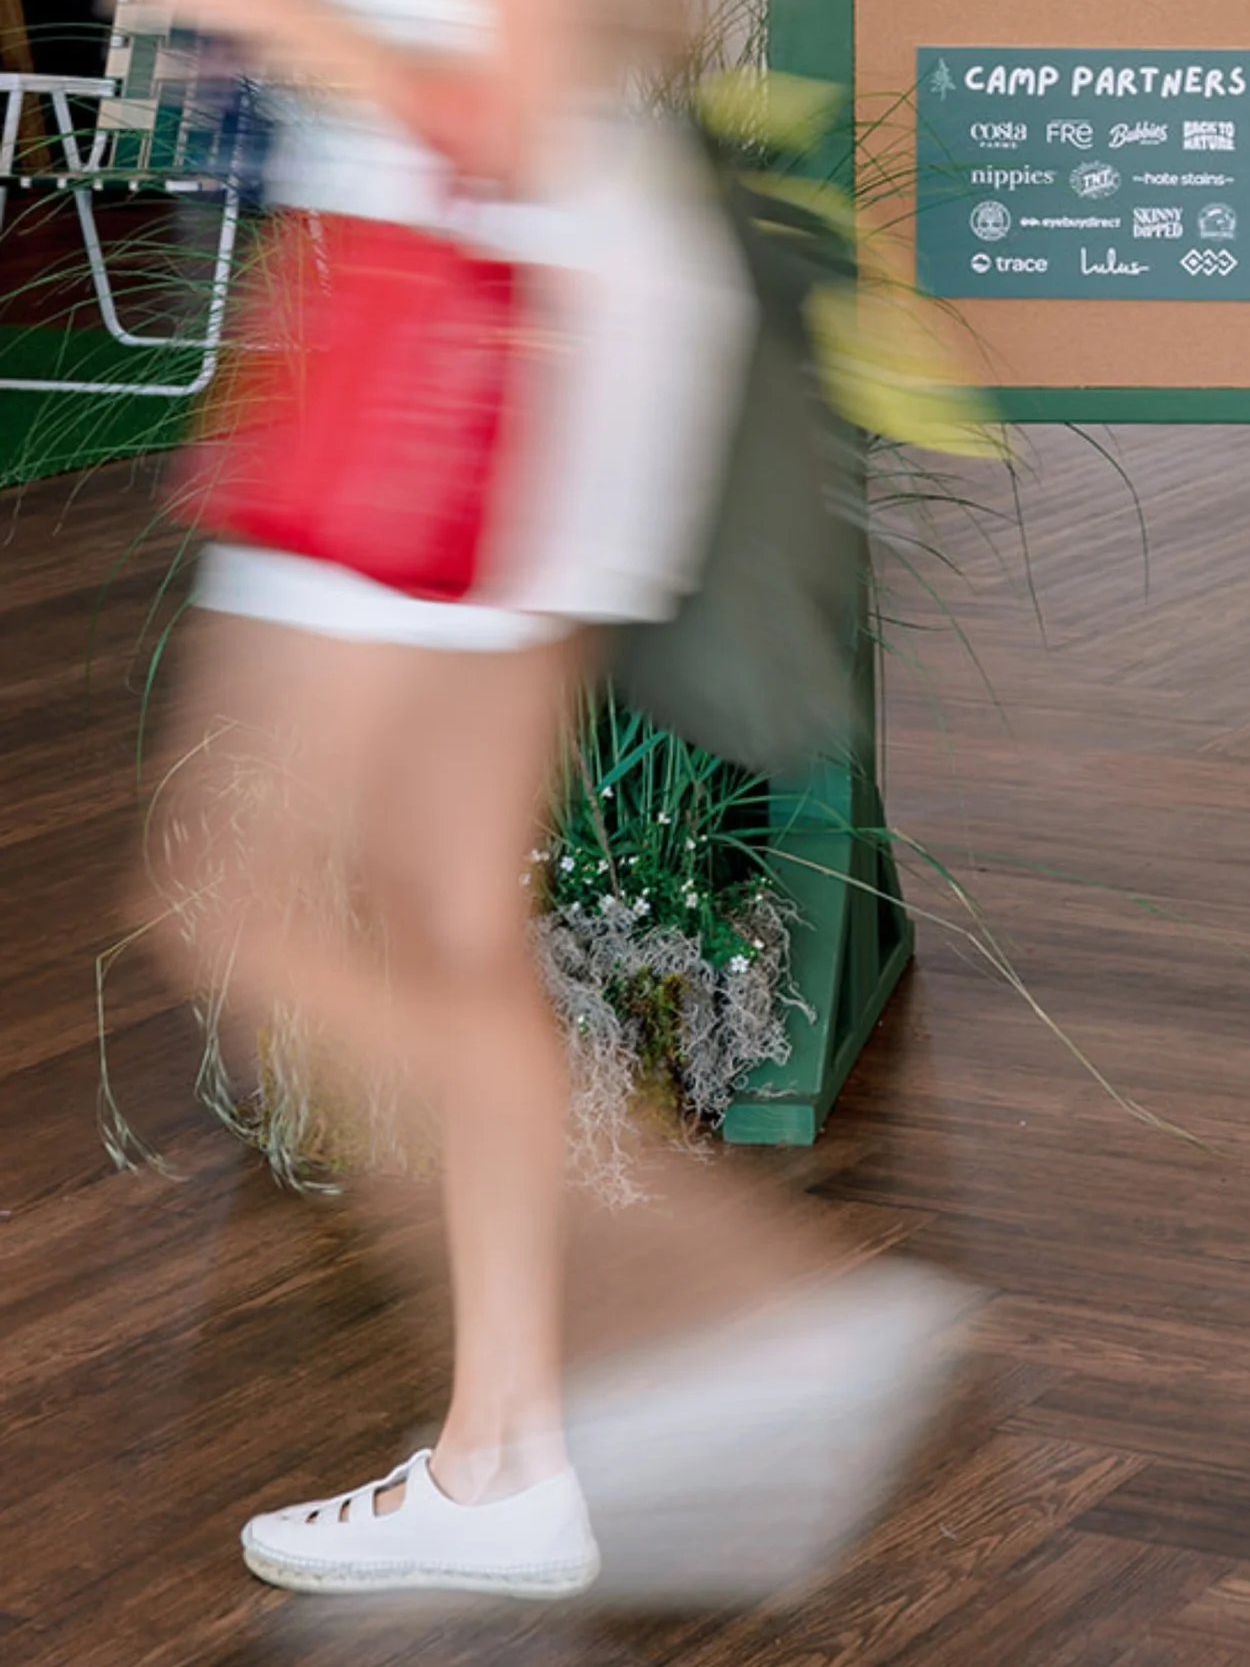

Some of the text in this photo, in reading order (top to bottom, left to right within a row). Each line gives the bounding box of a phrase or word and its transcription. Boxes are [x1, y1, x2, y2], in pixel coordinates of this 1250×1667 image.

[965, 65, 1247, 98] CAMP PARTNERS
[971, 165, 1056, 191] nippies
[996, 255, 1048, 272] trace
